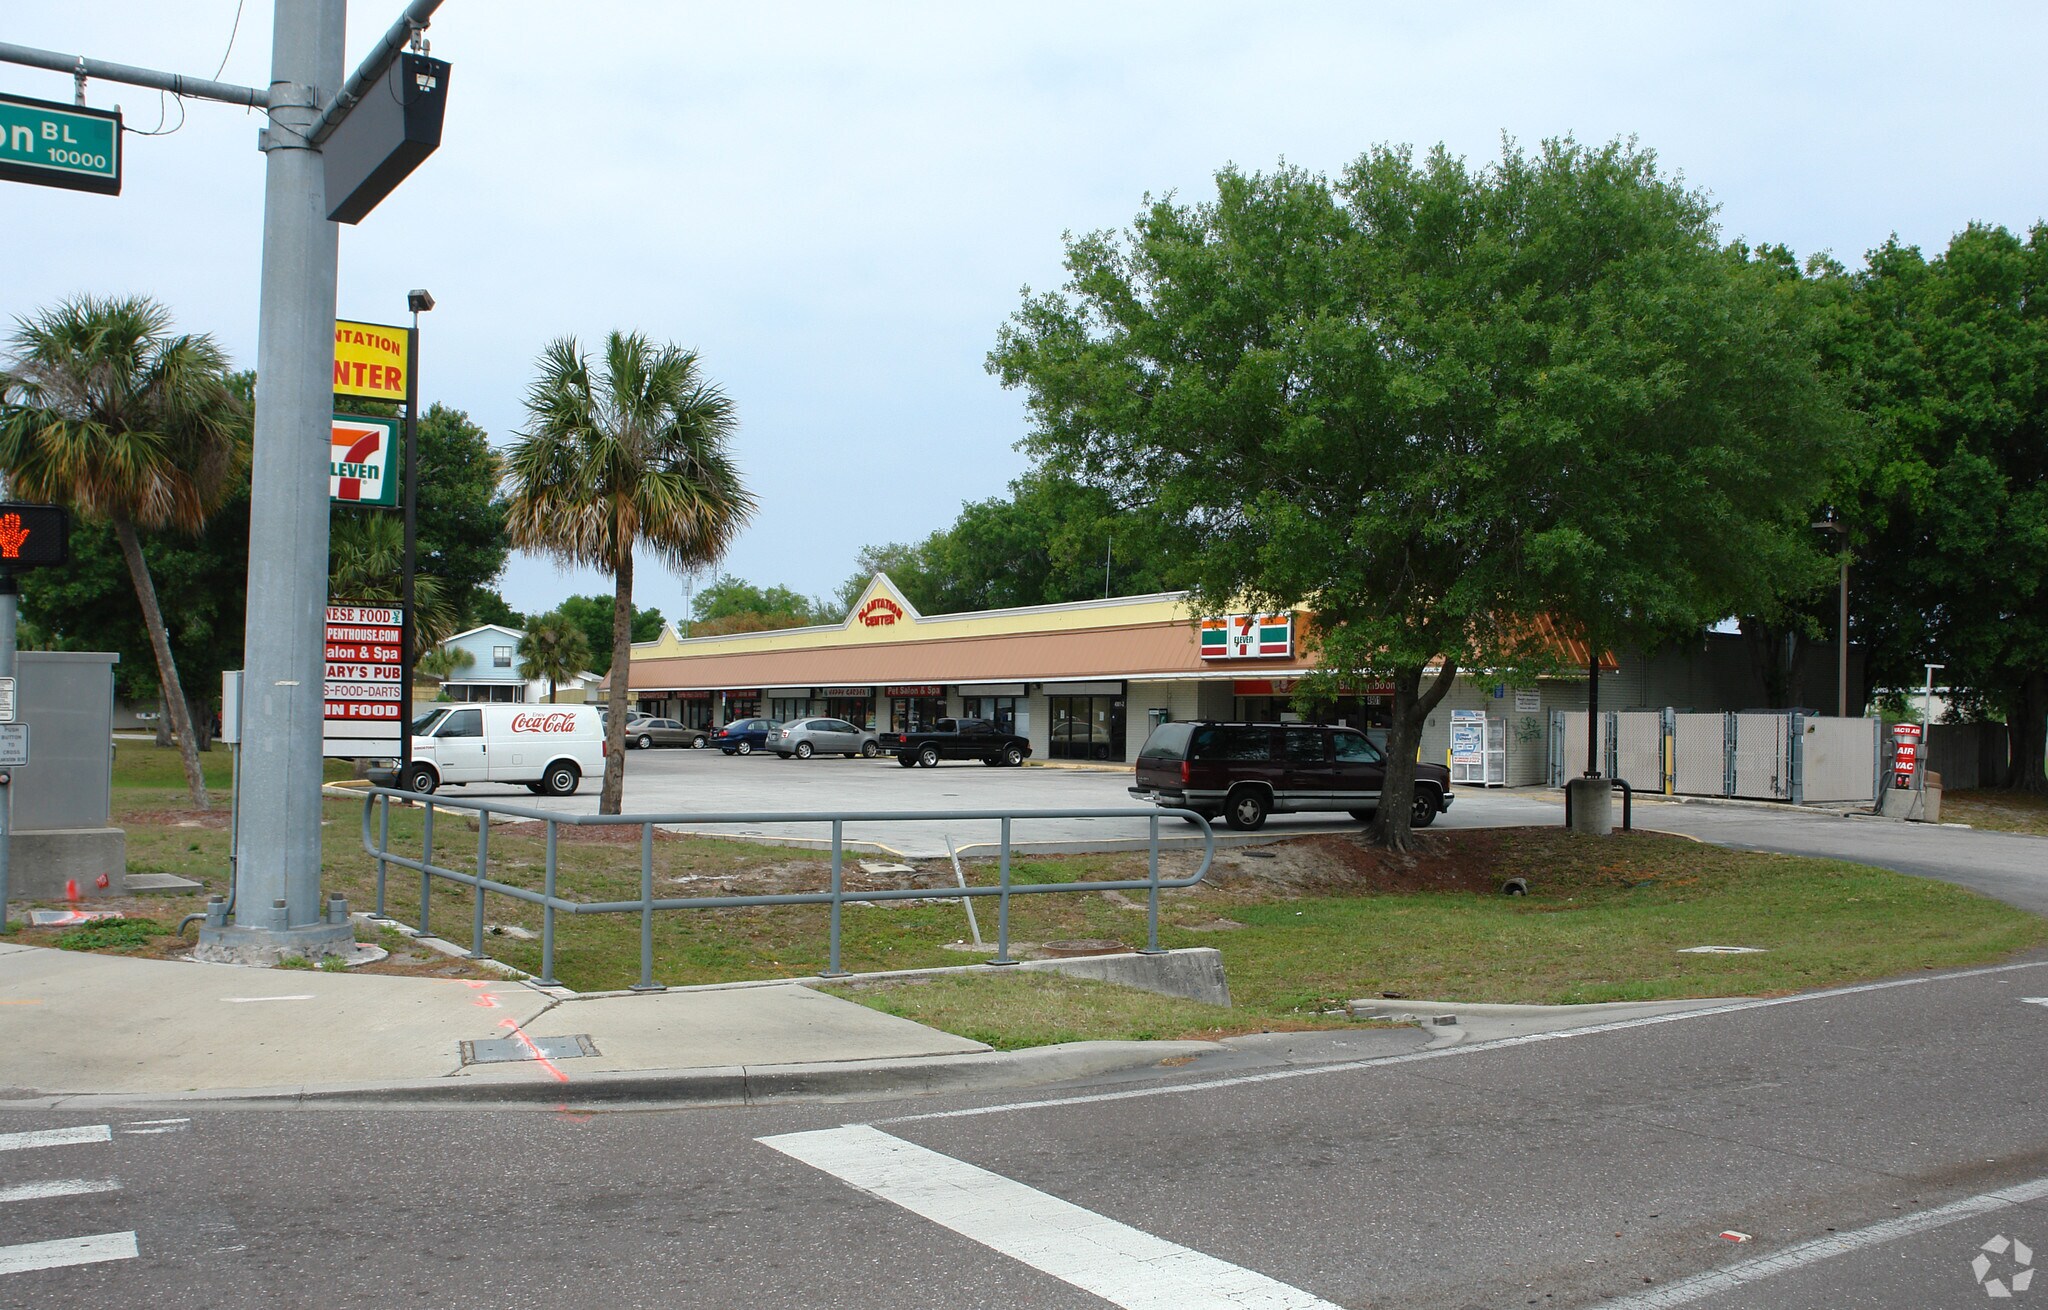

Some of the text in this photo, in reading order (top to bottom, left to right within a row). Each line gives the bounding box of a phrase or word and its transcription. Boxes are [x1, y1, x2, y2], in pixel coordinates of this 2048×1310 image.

[0, 121, 78, 152] n BL
[47, 147, 106, 169] 10000
[334, 360, 402, 392] NTER
[338, 431, 380, 500] 7
[359, 609, 391, 623] FOOD
[858, 598, 903, 623] PLANTATION
[865, 614, 895, 627] CENTER
[327, 627, 399, 642] PENTHOUSE.COM
[359, 646, 369, 659] &
[373, 646, 398, 662] Spa
[325, 665, 401, 679] ARY'S PUB
[887, 686, 898, 695] Pet
[900, 686, 919, 695] Salon
[927, 685, 941, 696] Spa
[325, 704, 398, 716] IN FOOD
